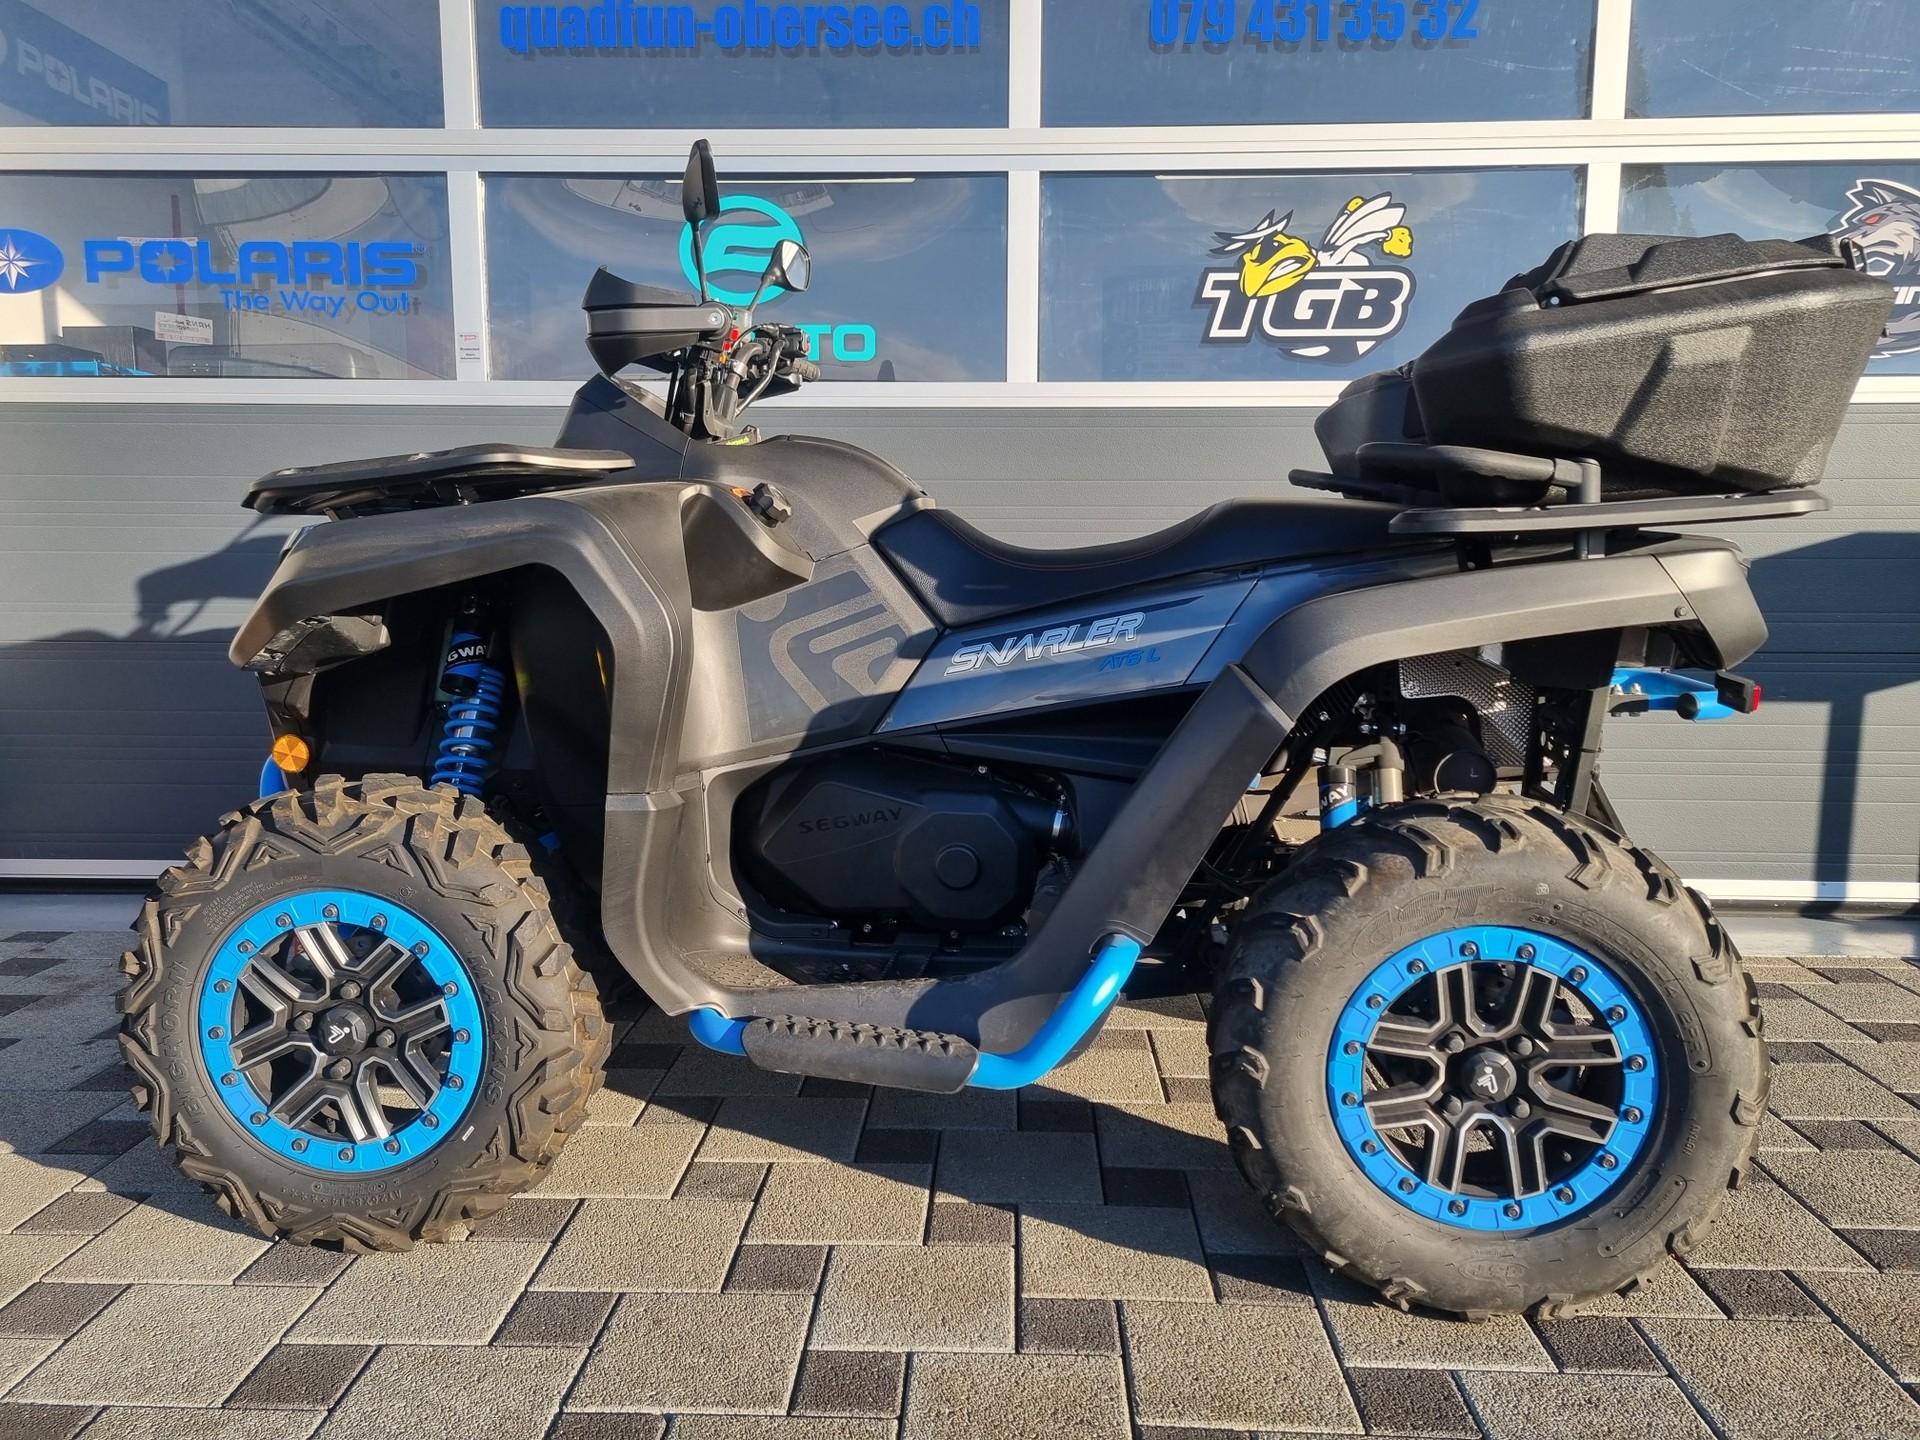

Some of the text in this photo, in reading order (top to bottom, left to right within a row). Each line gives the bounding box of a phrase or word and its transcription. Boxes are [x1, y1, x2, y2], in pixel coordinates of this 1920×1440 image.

[500, 0, 980, 53] quadfun-obersee.ch
[1150, 0, 1479, 44] 079 431 35 32
[219, 289, 410, 318] The Way Out
[1200, 270, 1413, 340] TGB
[943, 611, 1146, 677] SNARLER
[798, 807, 903, 834] SEGWAY
[466, 950, 508, 1107] MAXXIS
